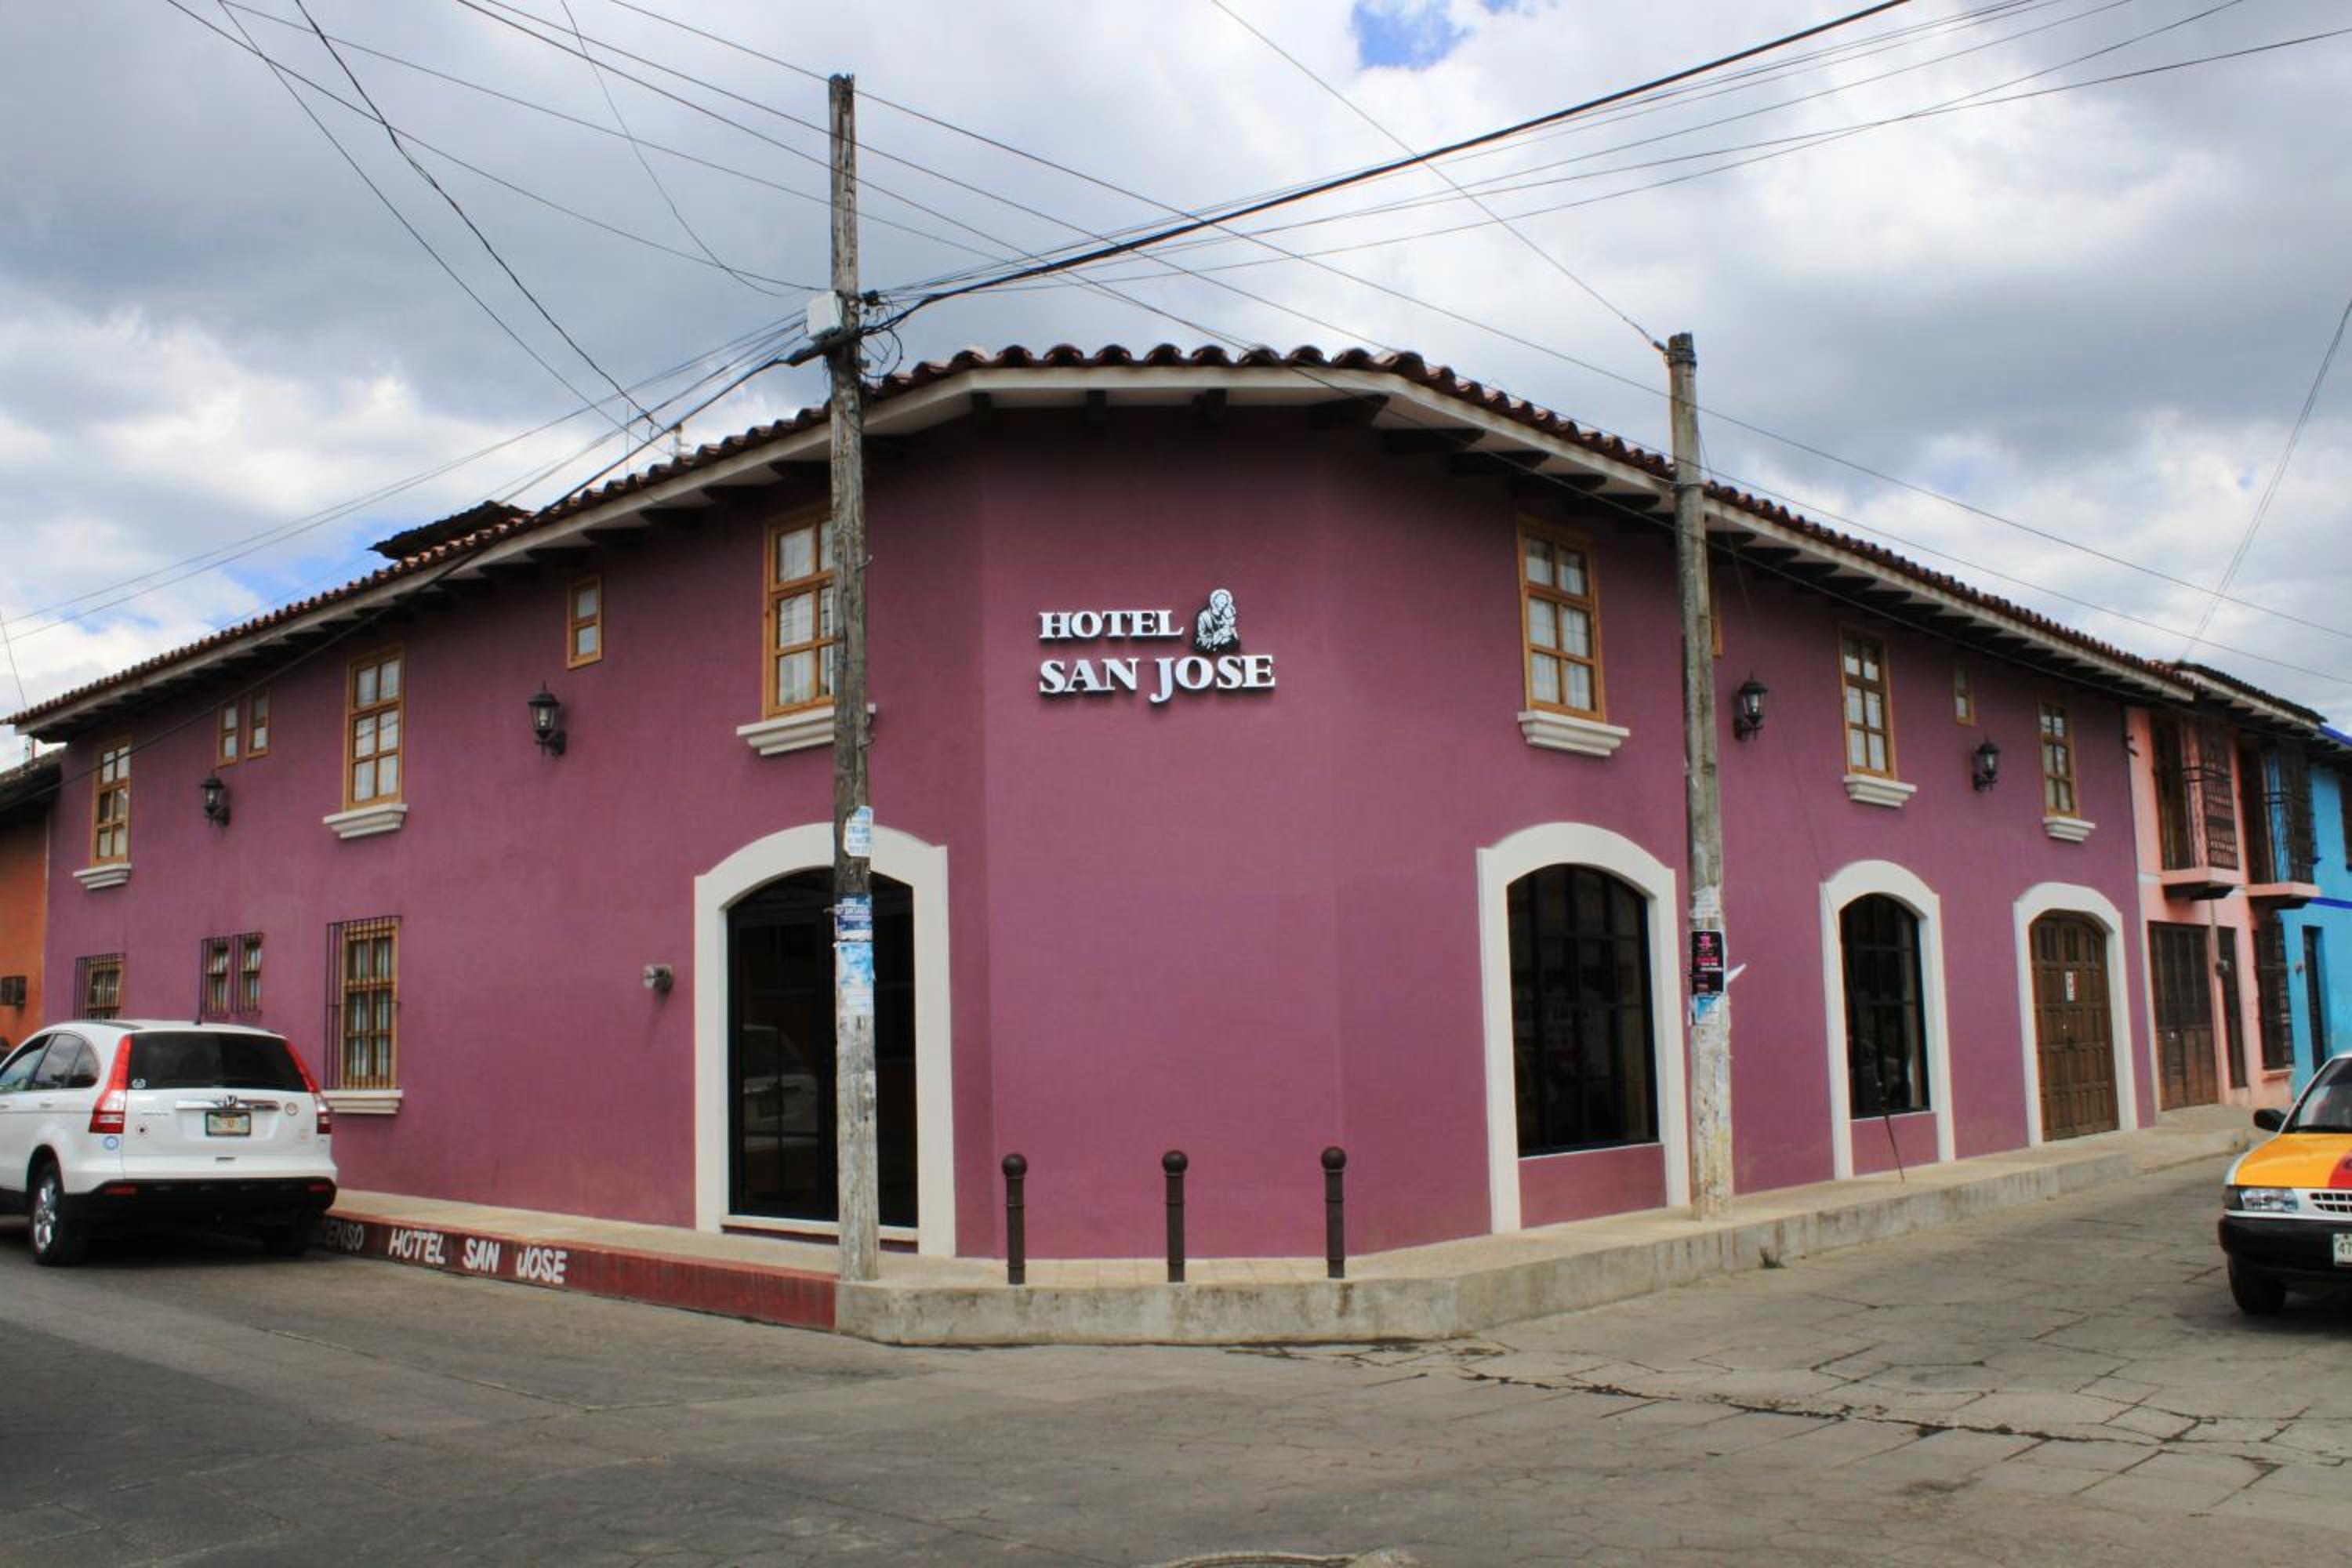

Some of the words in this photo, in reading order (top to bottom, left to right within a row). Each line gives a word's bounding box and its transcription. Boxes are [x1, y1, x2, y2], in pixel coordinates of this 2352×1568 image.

[1038, 609, 1185, 639] HOTEL
[1039, 657, 1140, 693] SAN
[1149, 654, 1276, 703] JOSE
[388, 1228, 446, 1265] HOTEL
[462, 1237, 501, 1273] SAN
[516, 1244, 568, 1285] JOSE
